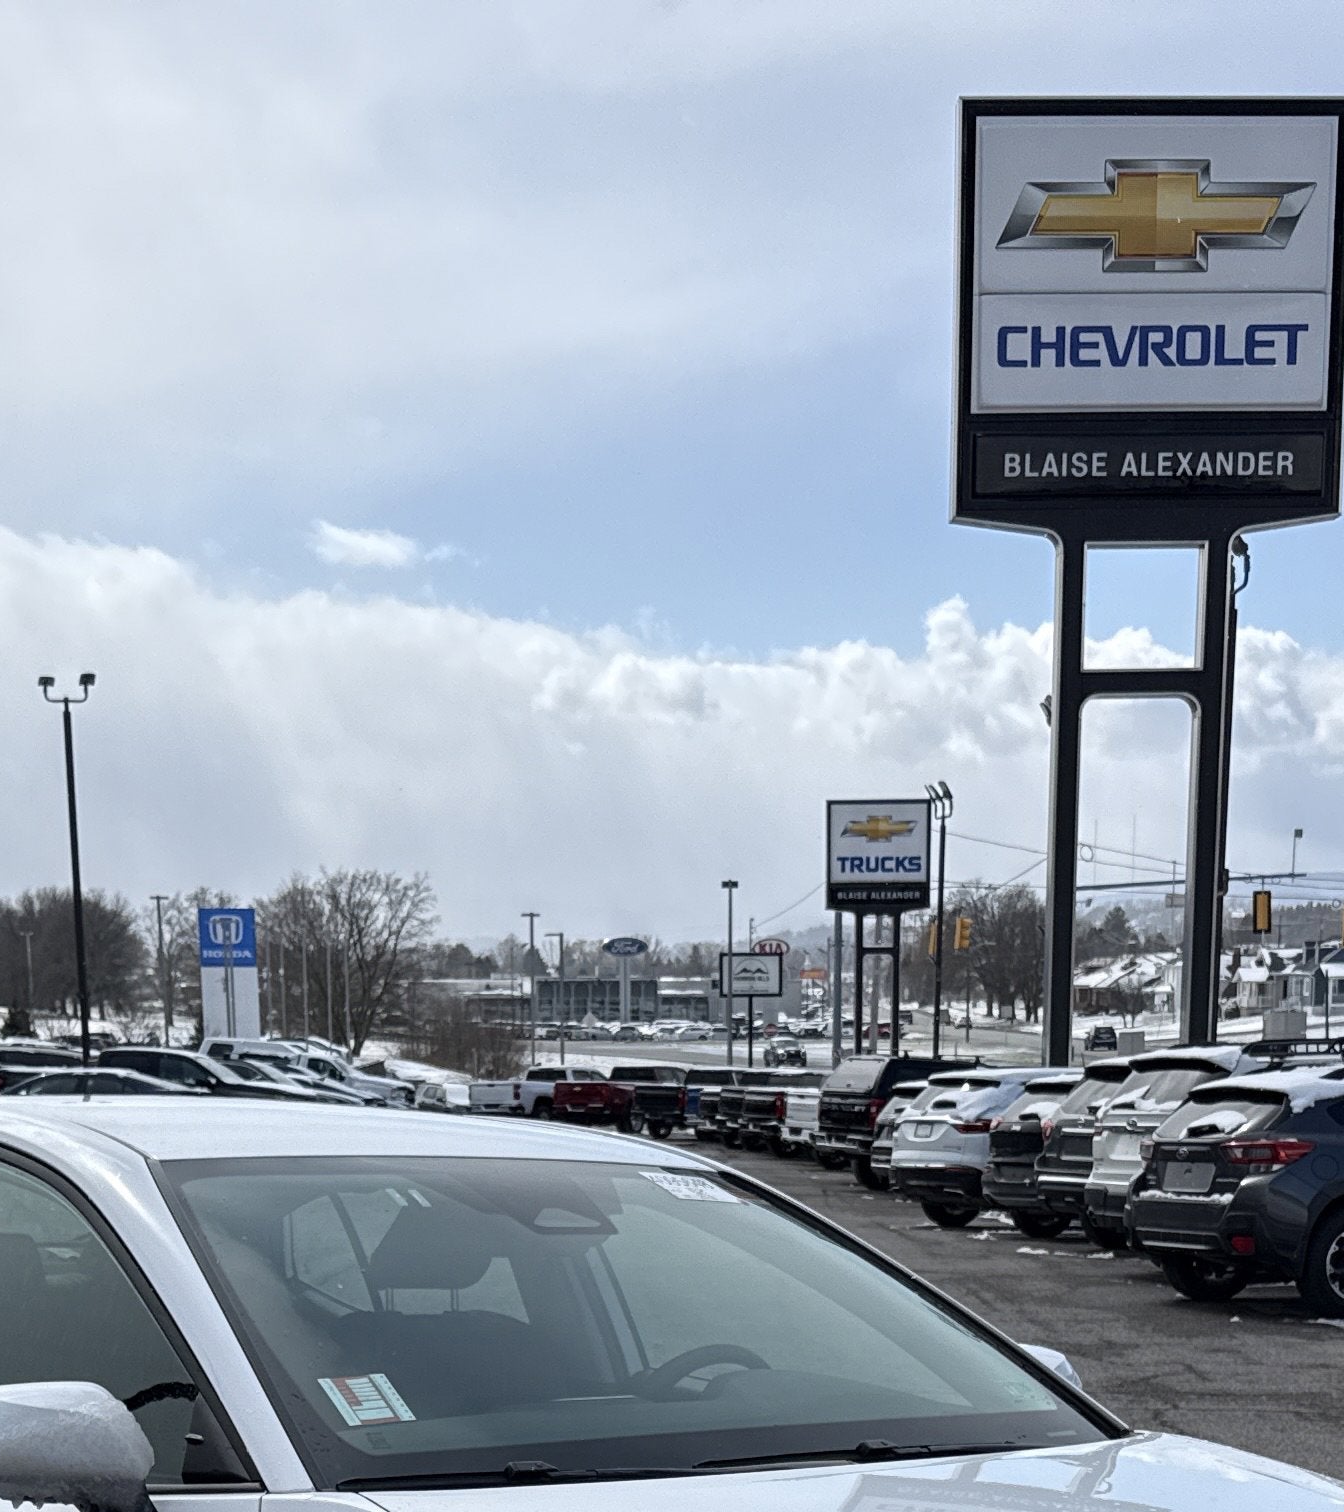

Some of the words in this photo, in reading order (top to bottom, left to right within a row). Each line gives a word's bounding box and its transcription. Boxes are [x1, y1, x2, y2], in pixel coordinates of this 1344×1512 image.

[997, 324, 1309, 367] CHEVROLET
[1004, 452, 1107, 477] BLAISE
[1120, 451, 1294, 477] ALEXANDER
[836, 856, 922, 873] TRUCKS
[758, 943, 783, 955] KIA
